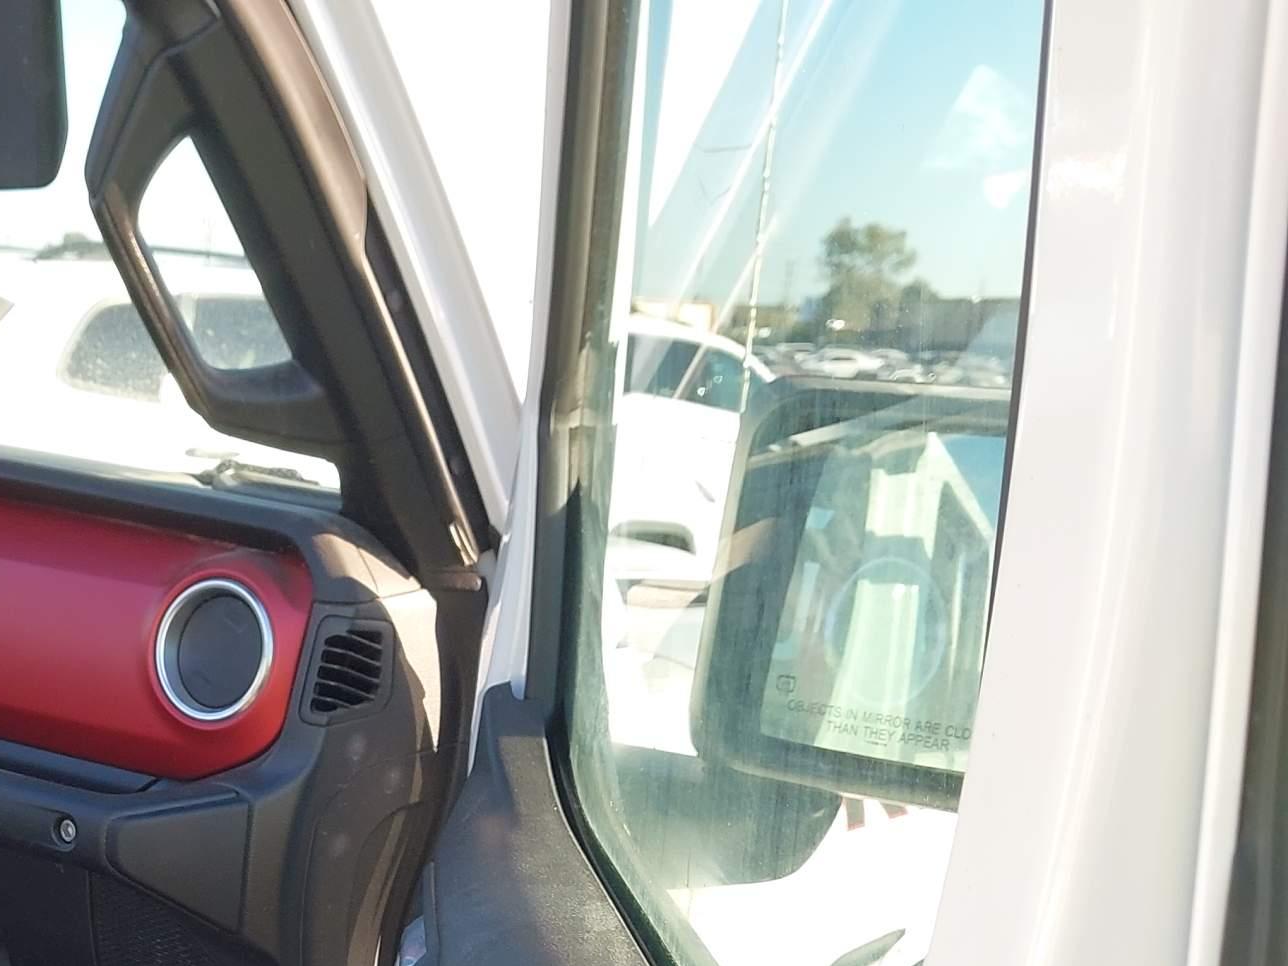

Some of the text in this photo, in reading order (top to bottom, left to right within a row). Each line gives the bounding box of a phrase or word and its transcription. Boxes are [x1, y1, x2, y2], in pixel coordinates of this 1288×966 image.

[787, 699, 842, 718] OBJECTS
[846, 708, 858, 721] IN
[863, 711, 911, 731] MIRROR
[915, 721, 941, 736] ARE
[827, 720, 951, 750] THAN THEY APPEAR
